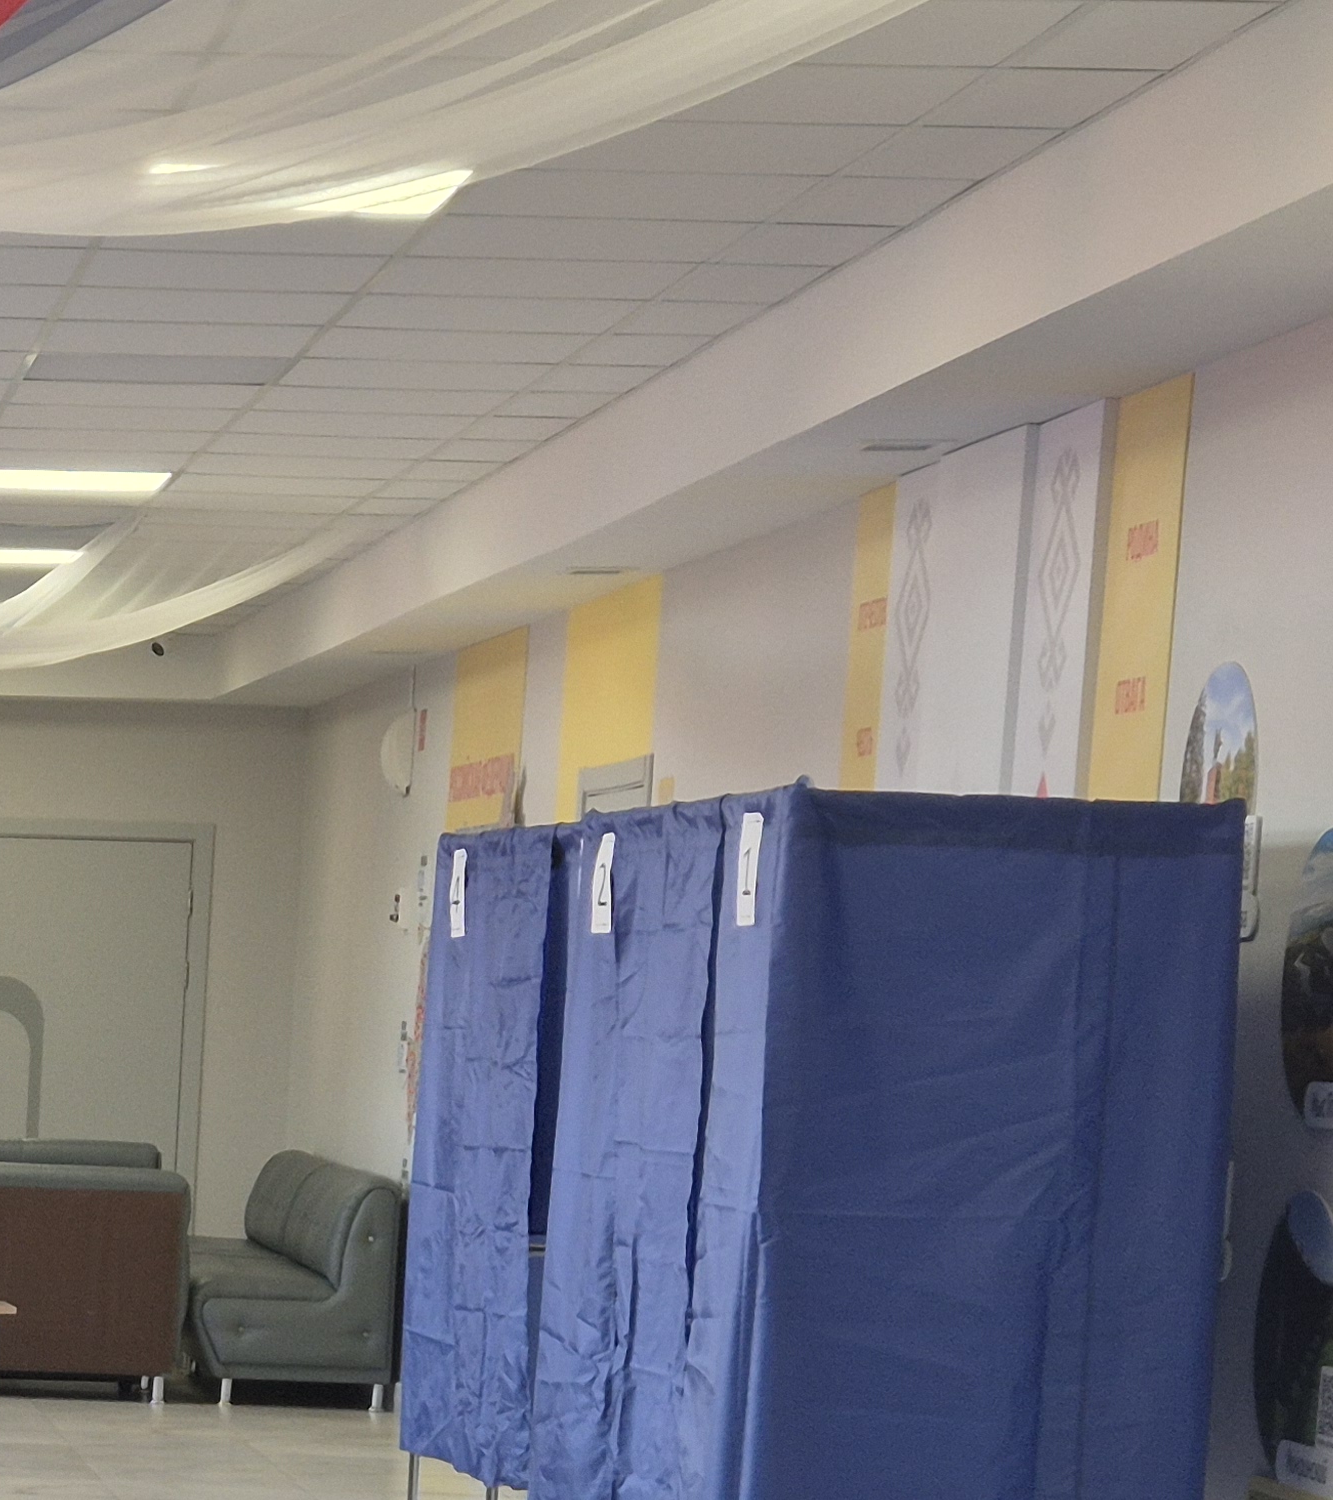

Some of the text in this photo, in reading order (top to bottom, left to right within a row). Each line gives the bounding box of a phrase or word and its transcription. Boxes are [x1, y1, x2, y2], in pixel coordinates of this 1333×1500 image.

[598, 863, 607, 906] 2
[743, 848, 751, 896] 1
[451, 876, 461, 913] 4
